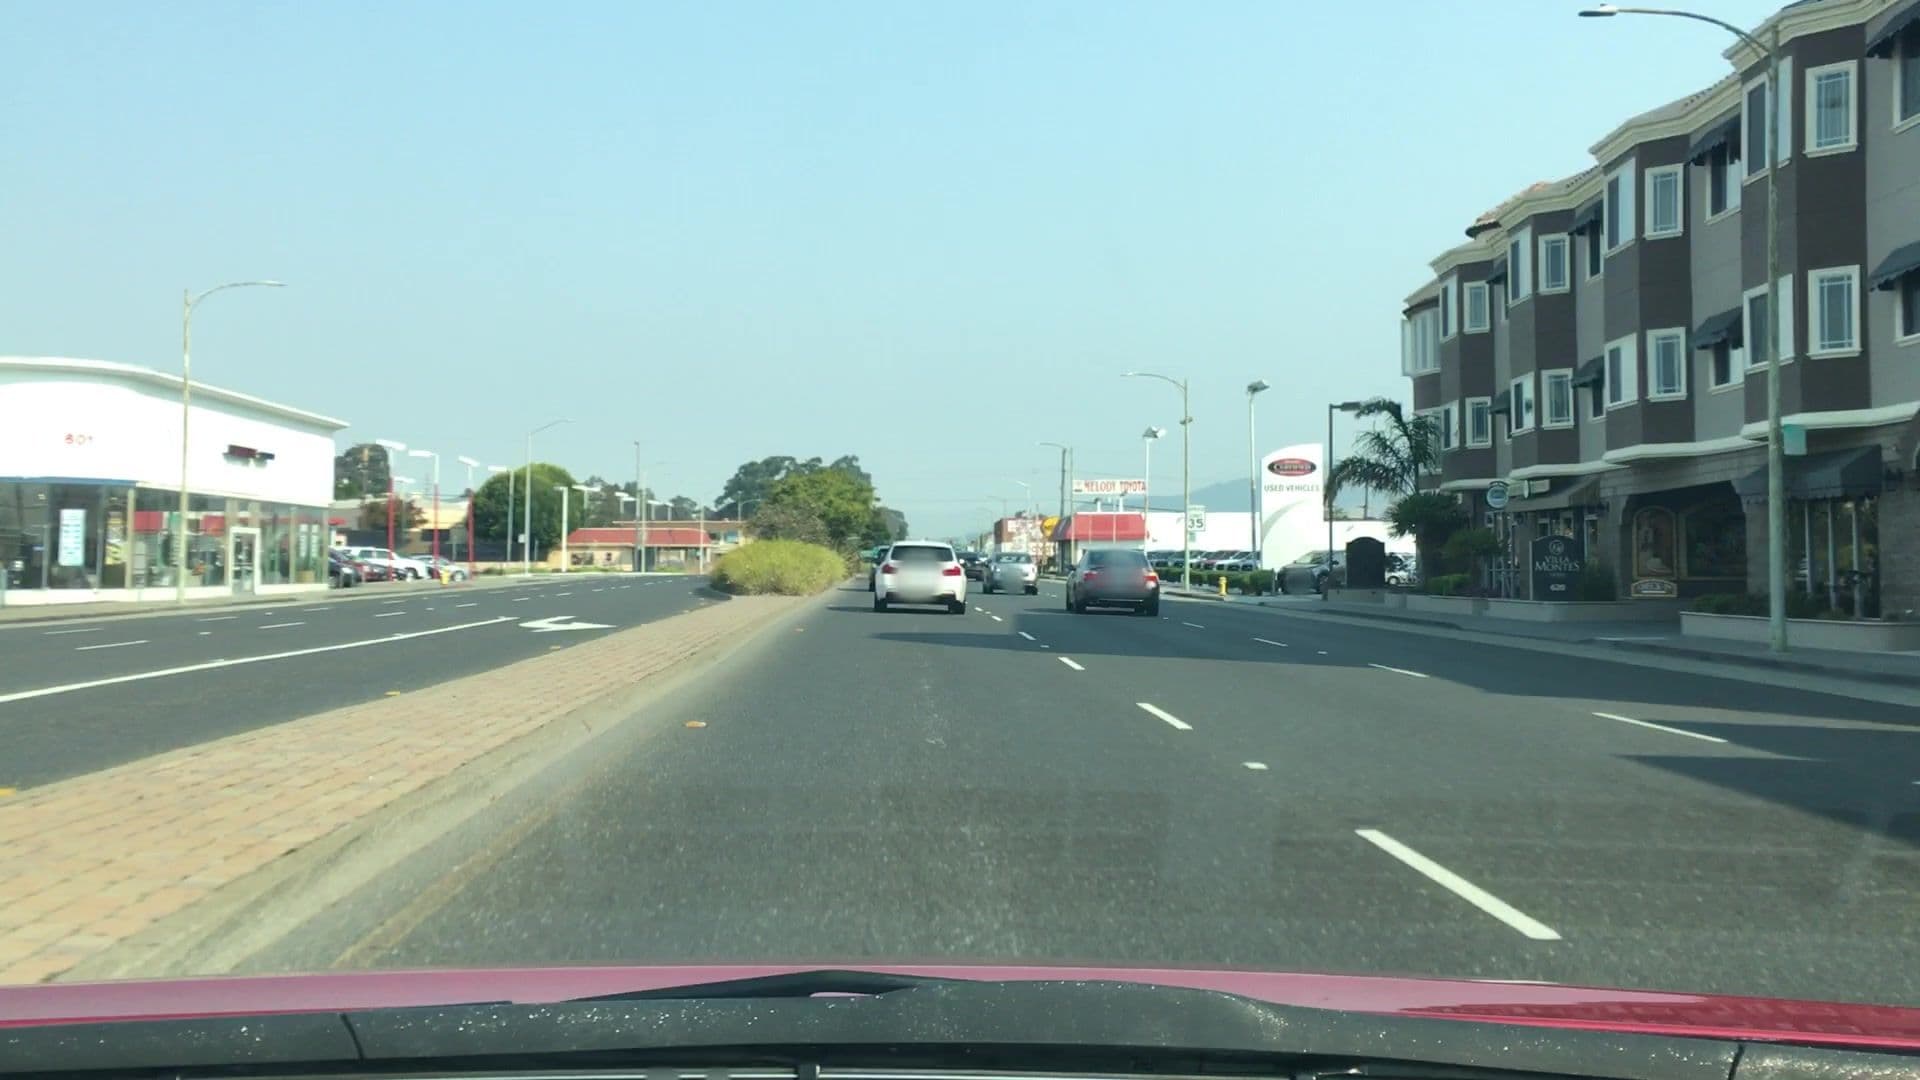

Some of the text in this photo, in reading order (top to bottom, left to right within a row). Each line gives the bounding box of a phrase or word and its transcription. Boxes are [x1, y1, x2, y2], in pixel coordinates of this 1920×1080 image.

[1084, 480, 1146, 492] MELODY TOYOTA
[1264, 484, 1320, 492] USED VEHICLES
[1188, 518, 1204, 529] 35
[1544, 555, 1570, 564] VILLA
[1535, 560, 1580, 572] MONTES
